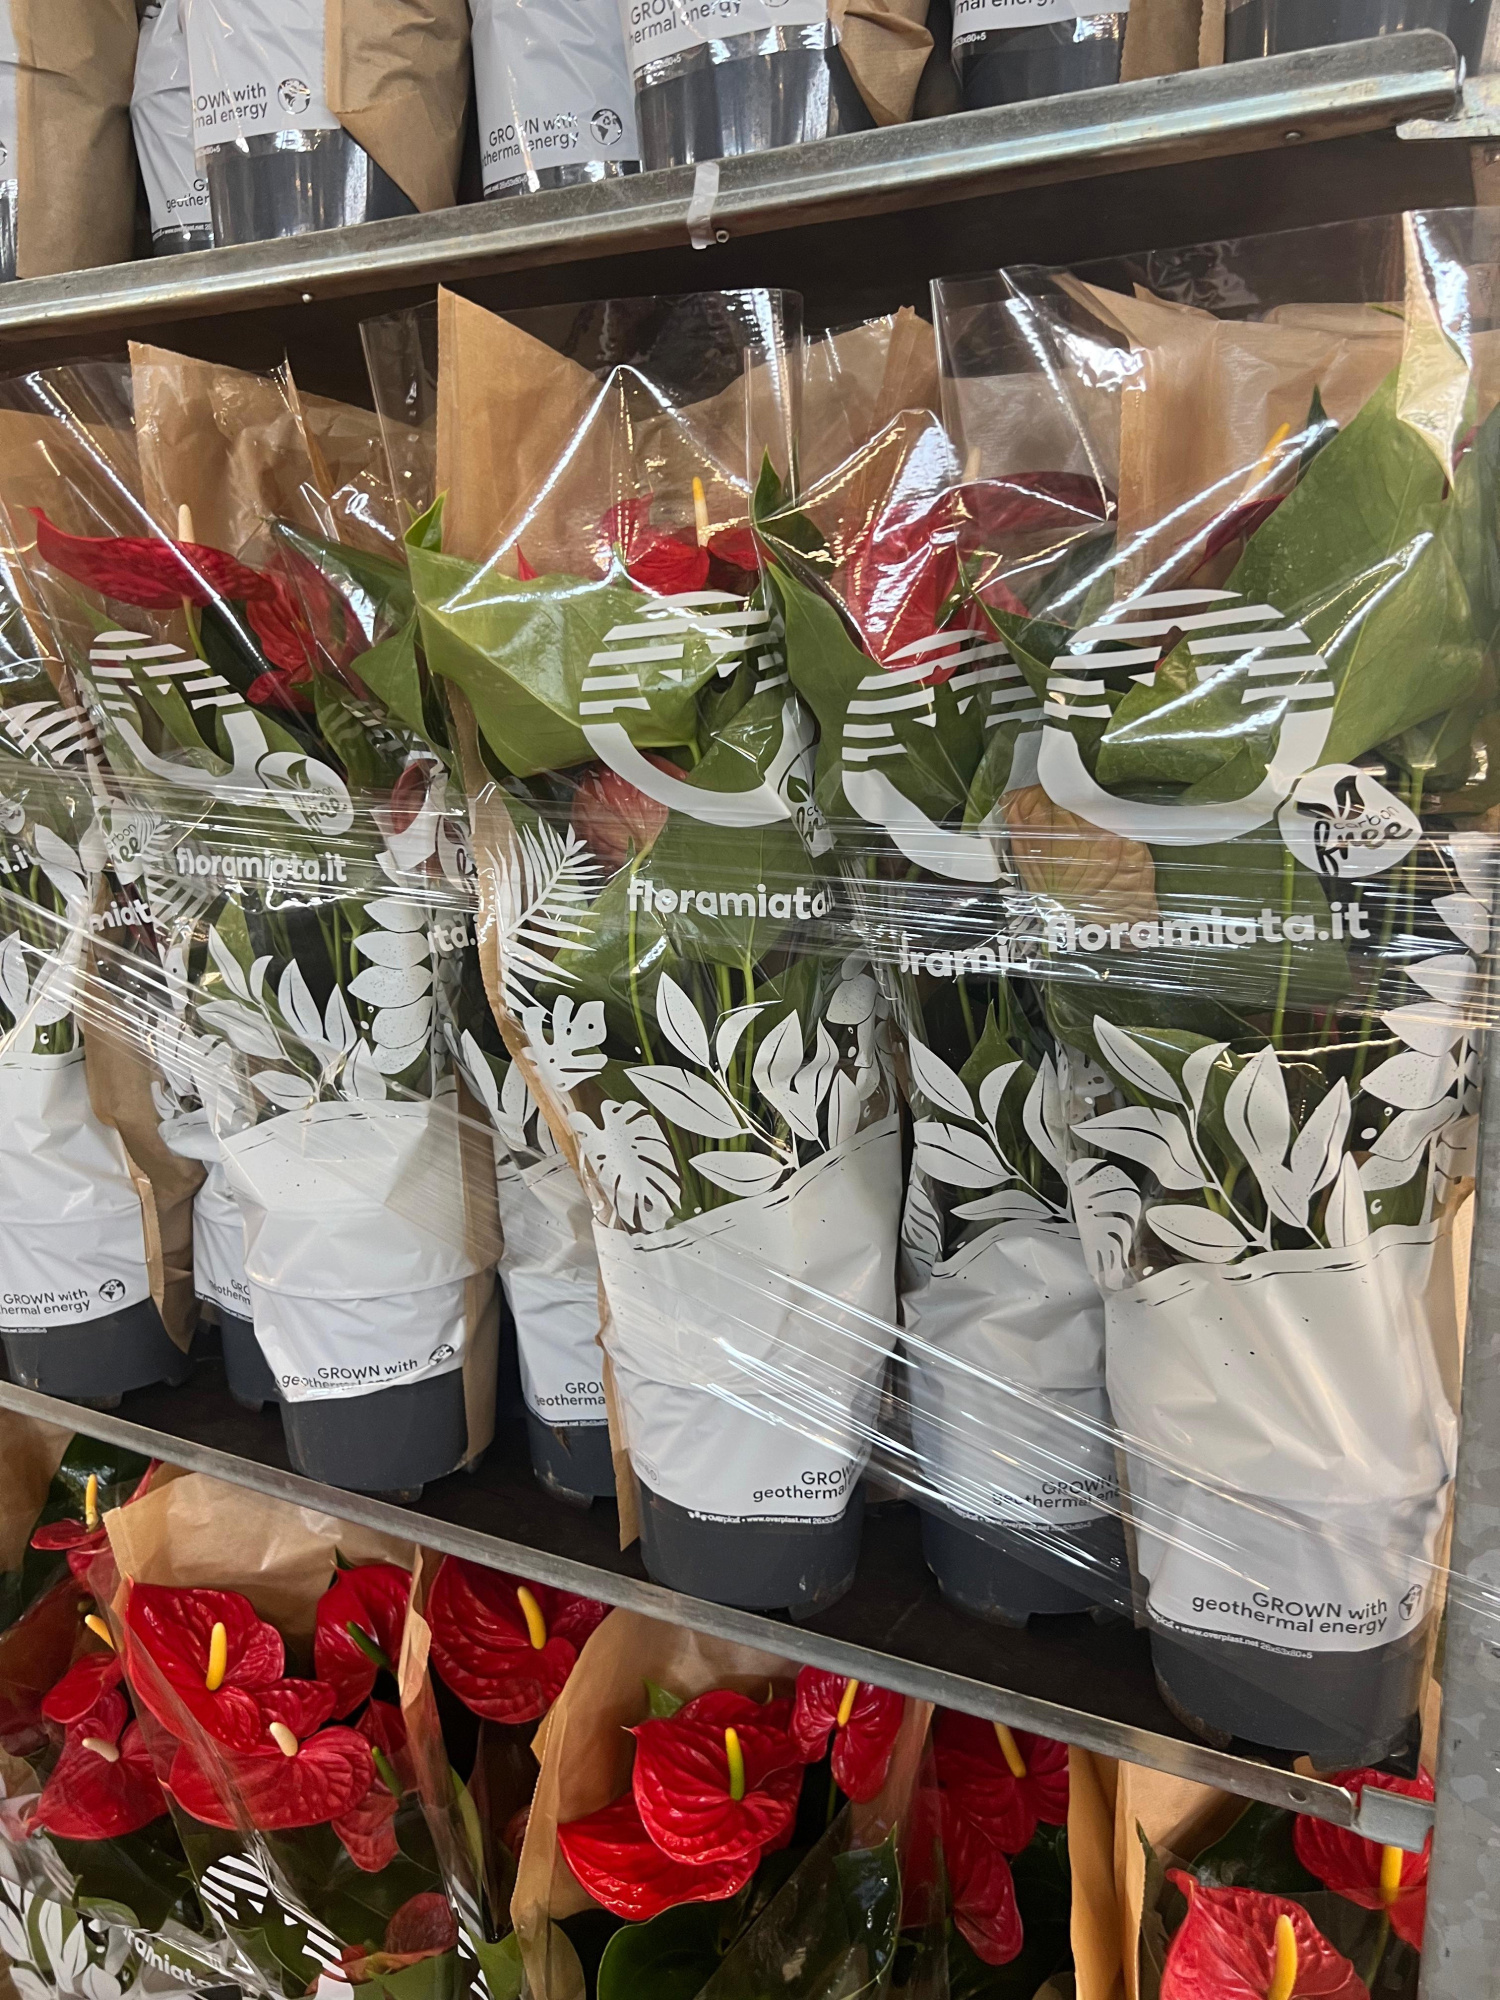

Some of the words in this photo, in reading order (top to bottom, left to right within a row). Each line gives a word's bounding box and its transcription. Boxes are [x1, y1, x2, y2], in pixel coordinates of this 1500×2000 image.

[194, 91, 231, 112] OWN
[233, 83, 266, 101] with
[220, 102, 268, 119] energy
[1333, 806, 1399, 829] carbon
[176, 847, 348, 882] floramiata.it
[1043, 901, 1371, 952] floramiata.it
[3, 1292, 55, 1305] GROWN
[58, 1288, 88, 1301] with
[43, 1299, 91, 1313] energy
[317, 1365, 380, 1380] GROWN
[384, 1358, 418, 1374] with
[1192, 1596, 1314, 1632] geothermal
[1319, 1616, 1388, 1635] energy
[1252, 1592, 1342, 1618] GROWN
[1348, 1598, 1387, 1620] with
